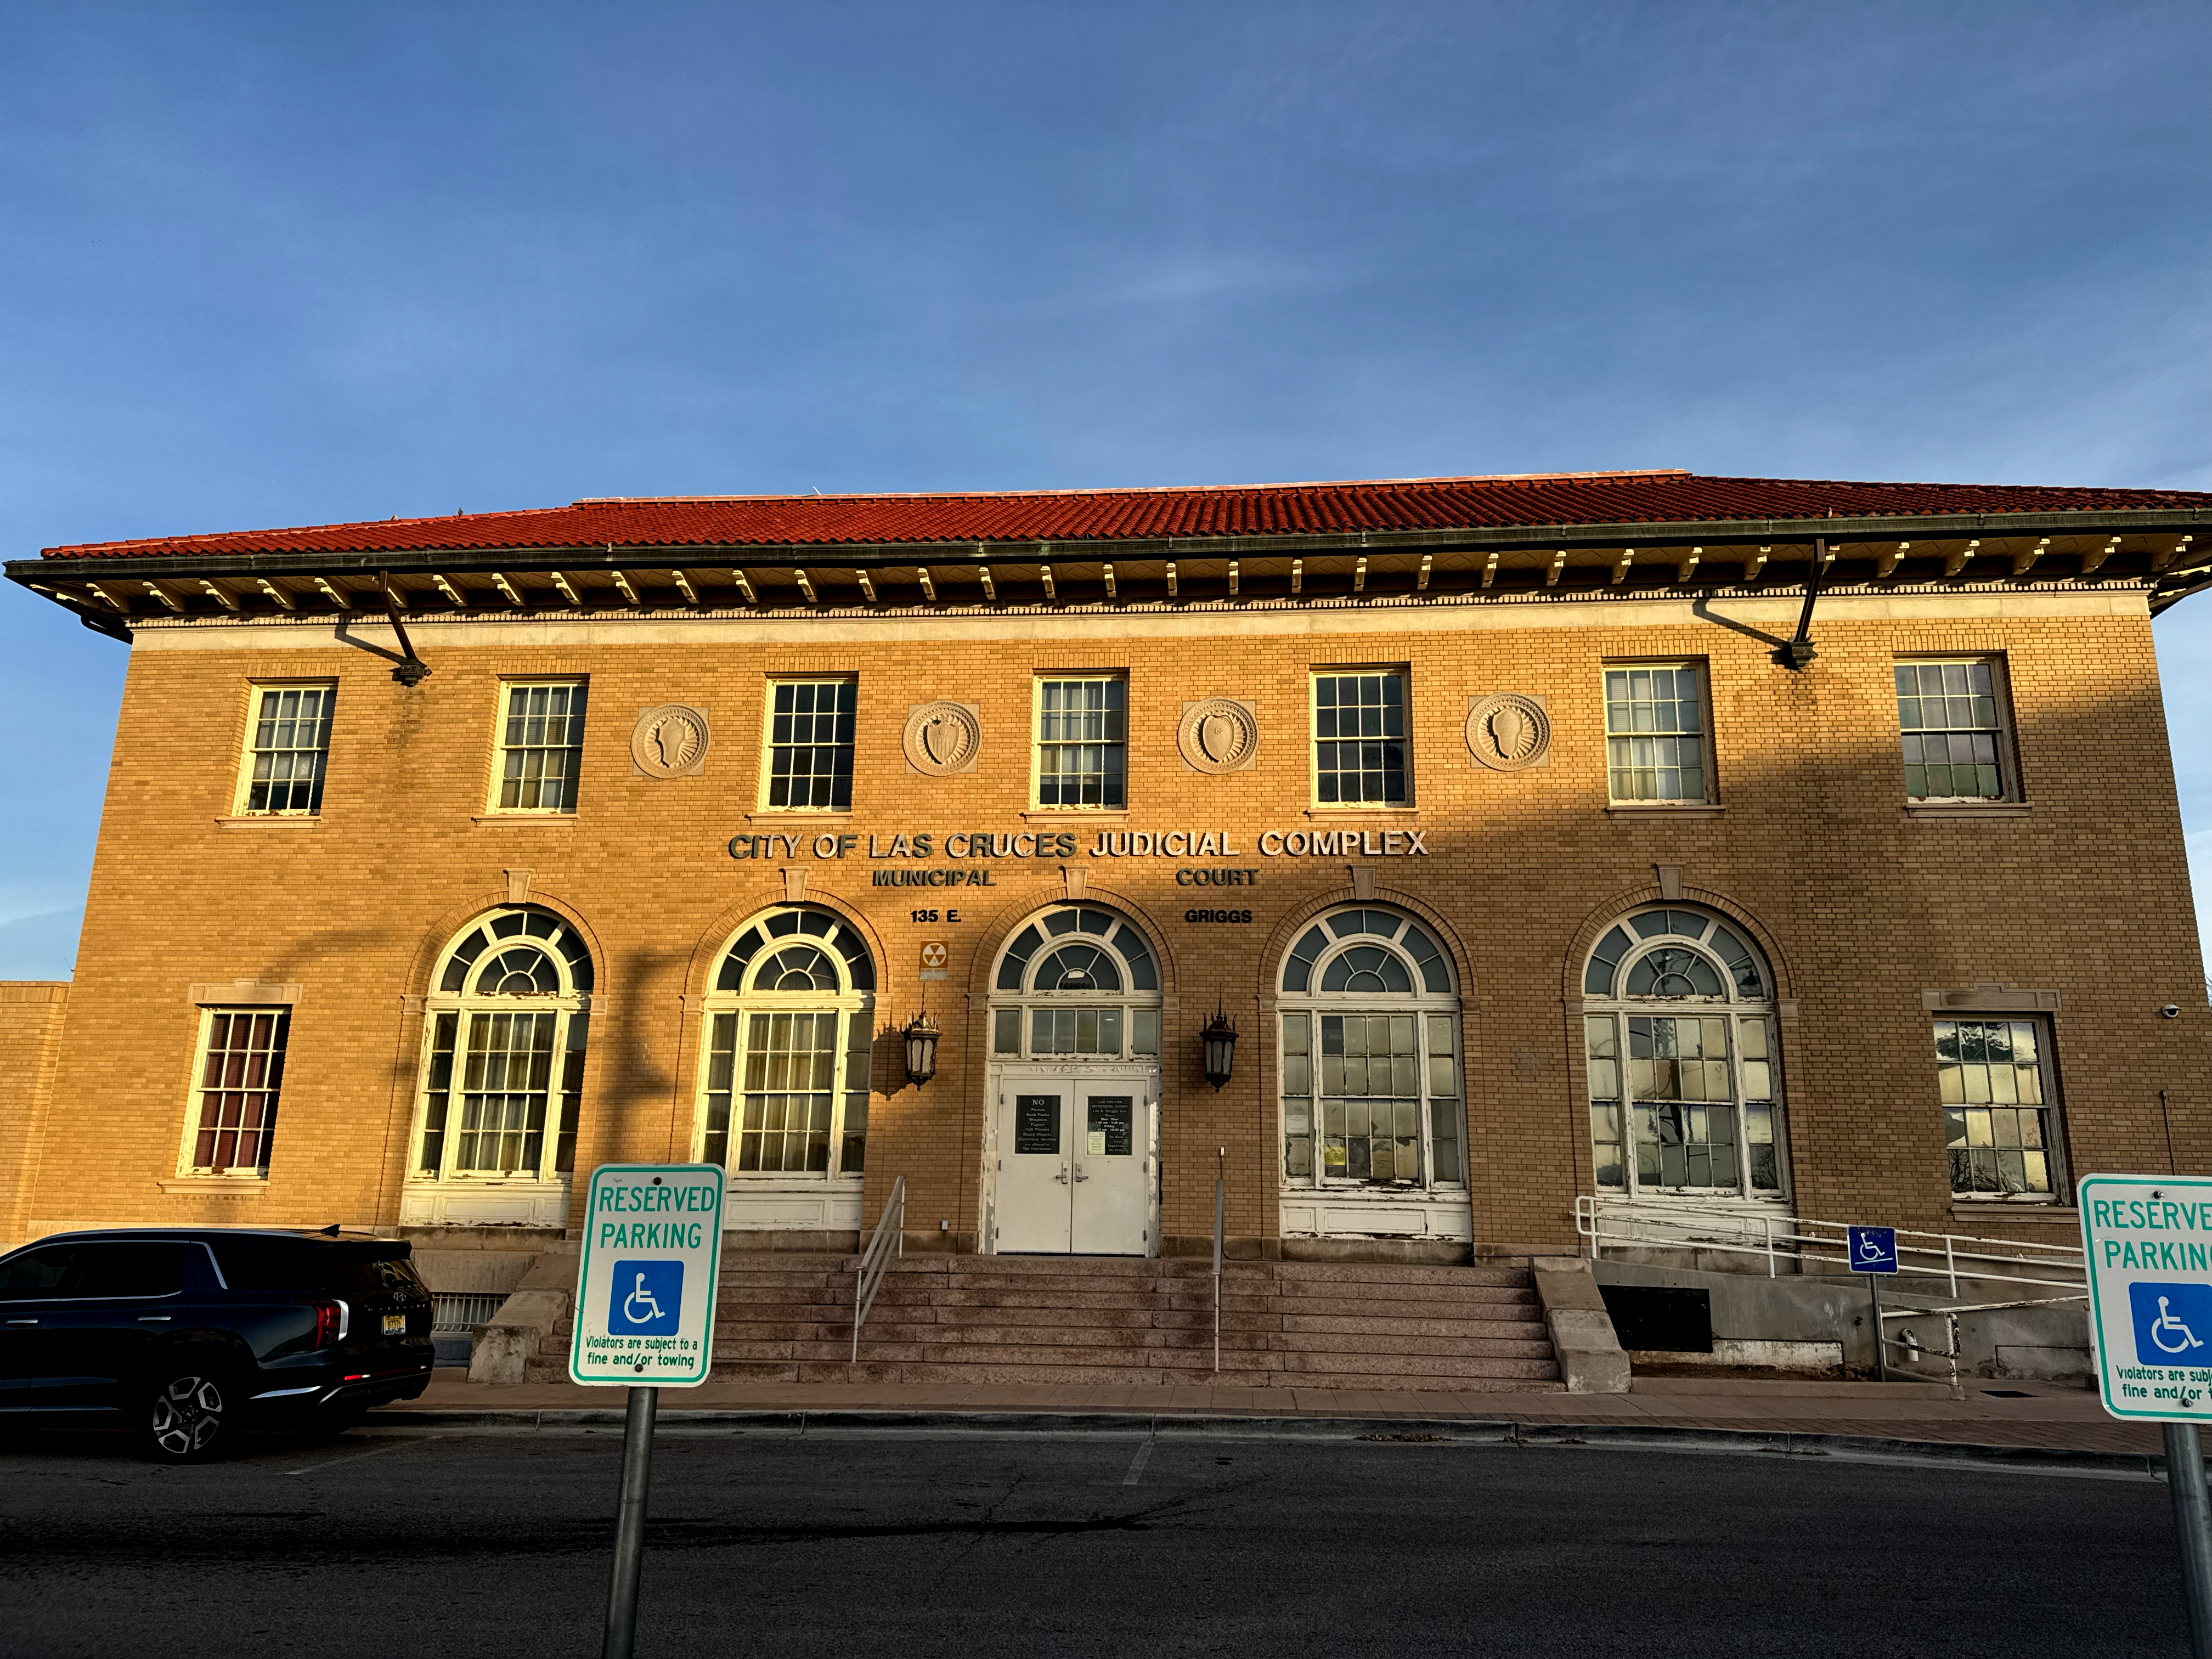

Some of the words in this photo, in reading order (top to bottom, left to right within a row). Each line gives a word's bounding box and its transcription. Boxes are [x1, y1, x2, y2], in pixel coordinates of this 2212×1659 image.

[729, 833, 804, 859] CITY
[814, 833, 859, 858] OF
[871, 833, 933, 858] LAS
[946, 832, 1076, 857] CRUCES
[1092, 831, 1240, 856] JUDICIAL
[1260, 831, 1429, 856] COMPLEX
[873, 869, 996, 887] MUNICIPAL
[1176, 868, 1260, 885] COURT
[910, 909, 939, 923] 135
[947, 909, 962, 923] E.
[1186, 909, 1252, 923] GRIGGS
[599, 1186, 715, 1212] RESERVED
[2093, 1199, 2212, 1231] RESERVE
[600, 1222, 702, 1249] PARKING
[2104, 1240, 2212, 1271] PARKIN
[586, 1335, 624, 1348] Violators
[627, 1338, 641, 1349] are
[645, 1337, 676, 1353] subject
[680, 1338, 689, 1350] to
[692, 1340, 698, 1350] a
[588, 1352, 608, 1364] fine
[612, 1353, 653, 1365] and/or
[658, 1353, 695, 1370] towing
[2116, 1365, 2164, 1381] Violators
[2168, 1369, 2185, 1381] are
[2190, 1369, 2212, 1387] subj
[2122, 1383, 2148, 1398] fine
[2154, 1386, 2203, 1400] and/or
